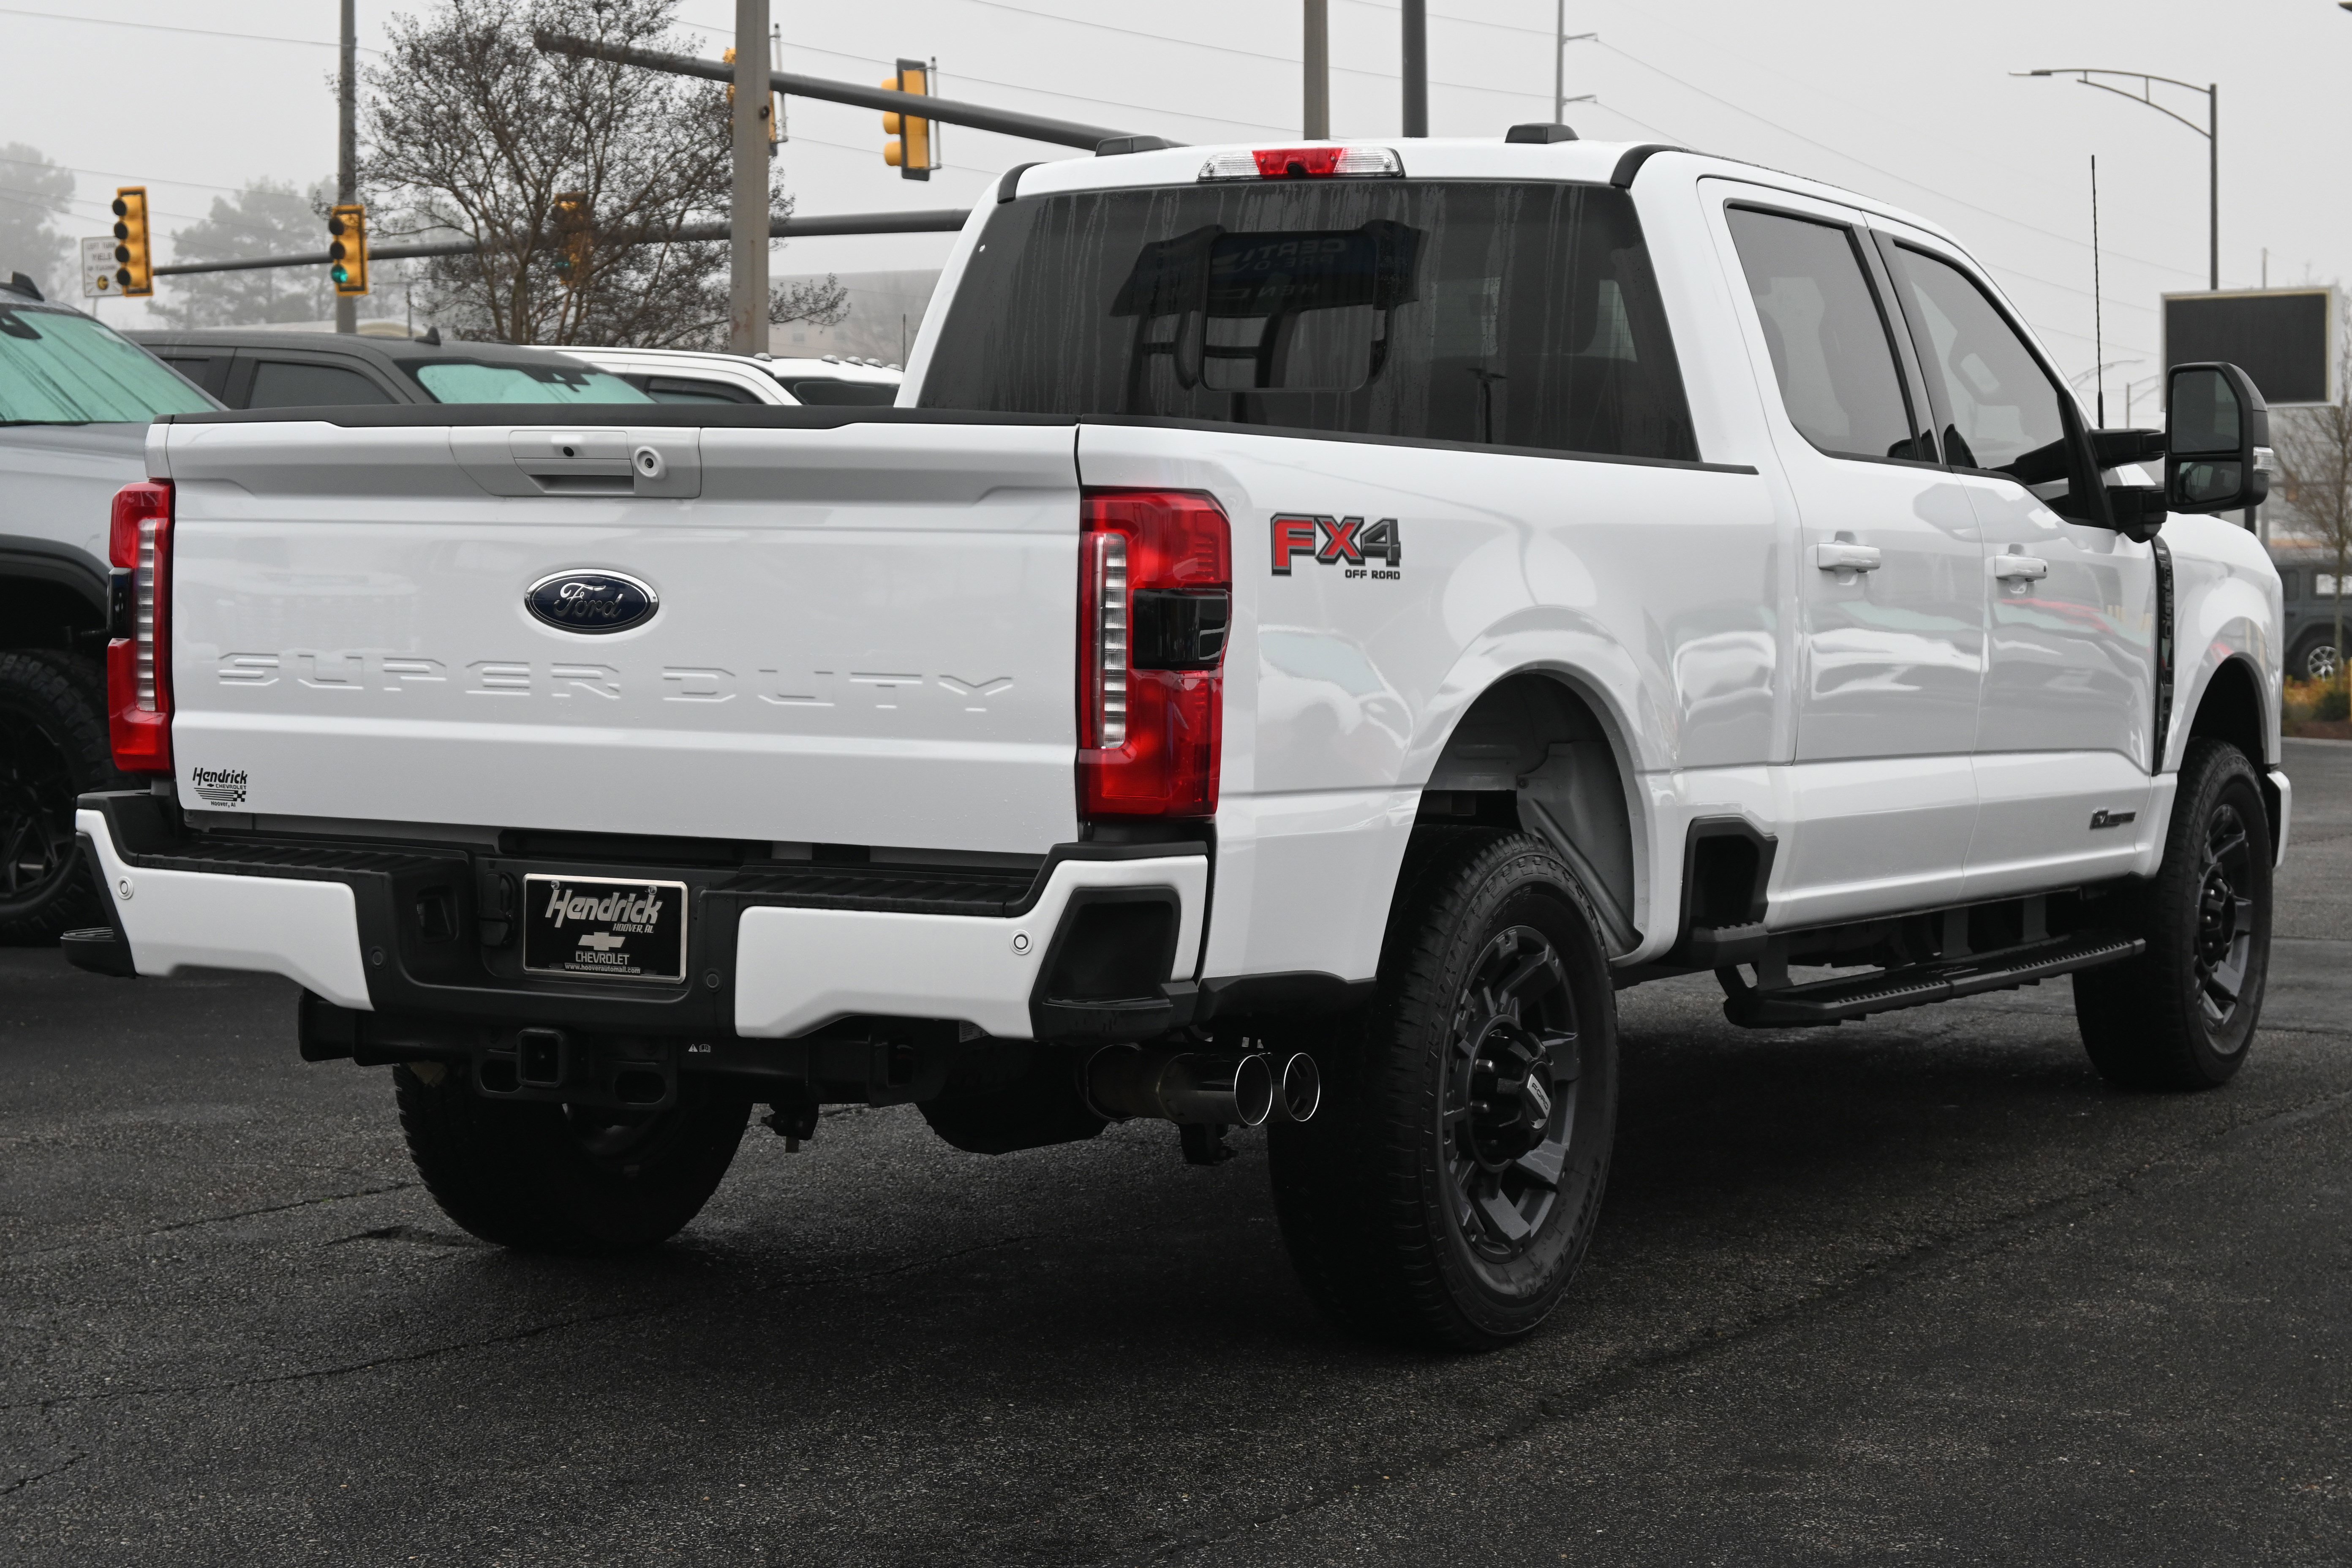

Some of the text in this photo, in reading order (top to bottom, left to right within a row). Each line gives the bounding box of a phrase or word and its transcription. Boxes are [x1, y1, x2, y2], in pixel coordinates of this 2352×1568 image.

[1270, 512, 1401, 576] FX4
[1345, 569, 1400, 580] OFF ROAD
[554, 582, 623, 618] Ford
[219, 652, 1013, 712] SUPER DUTY
[193, 767, 248, 786] Hendrick
[545, 889, 663, 928] Hendrick
[612, 923, 654, 934] HOOVER, AL
[564, 963, 640, 974] www.hooverautomall.com
[575, 951, 630, 965] CHEVROLET
[1532, 1083, 1549, 1110] FORD
